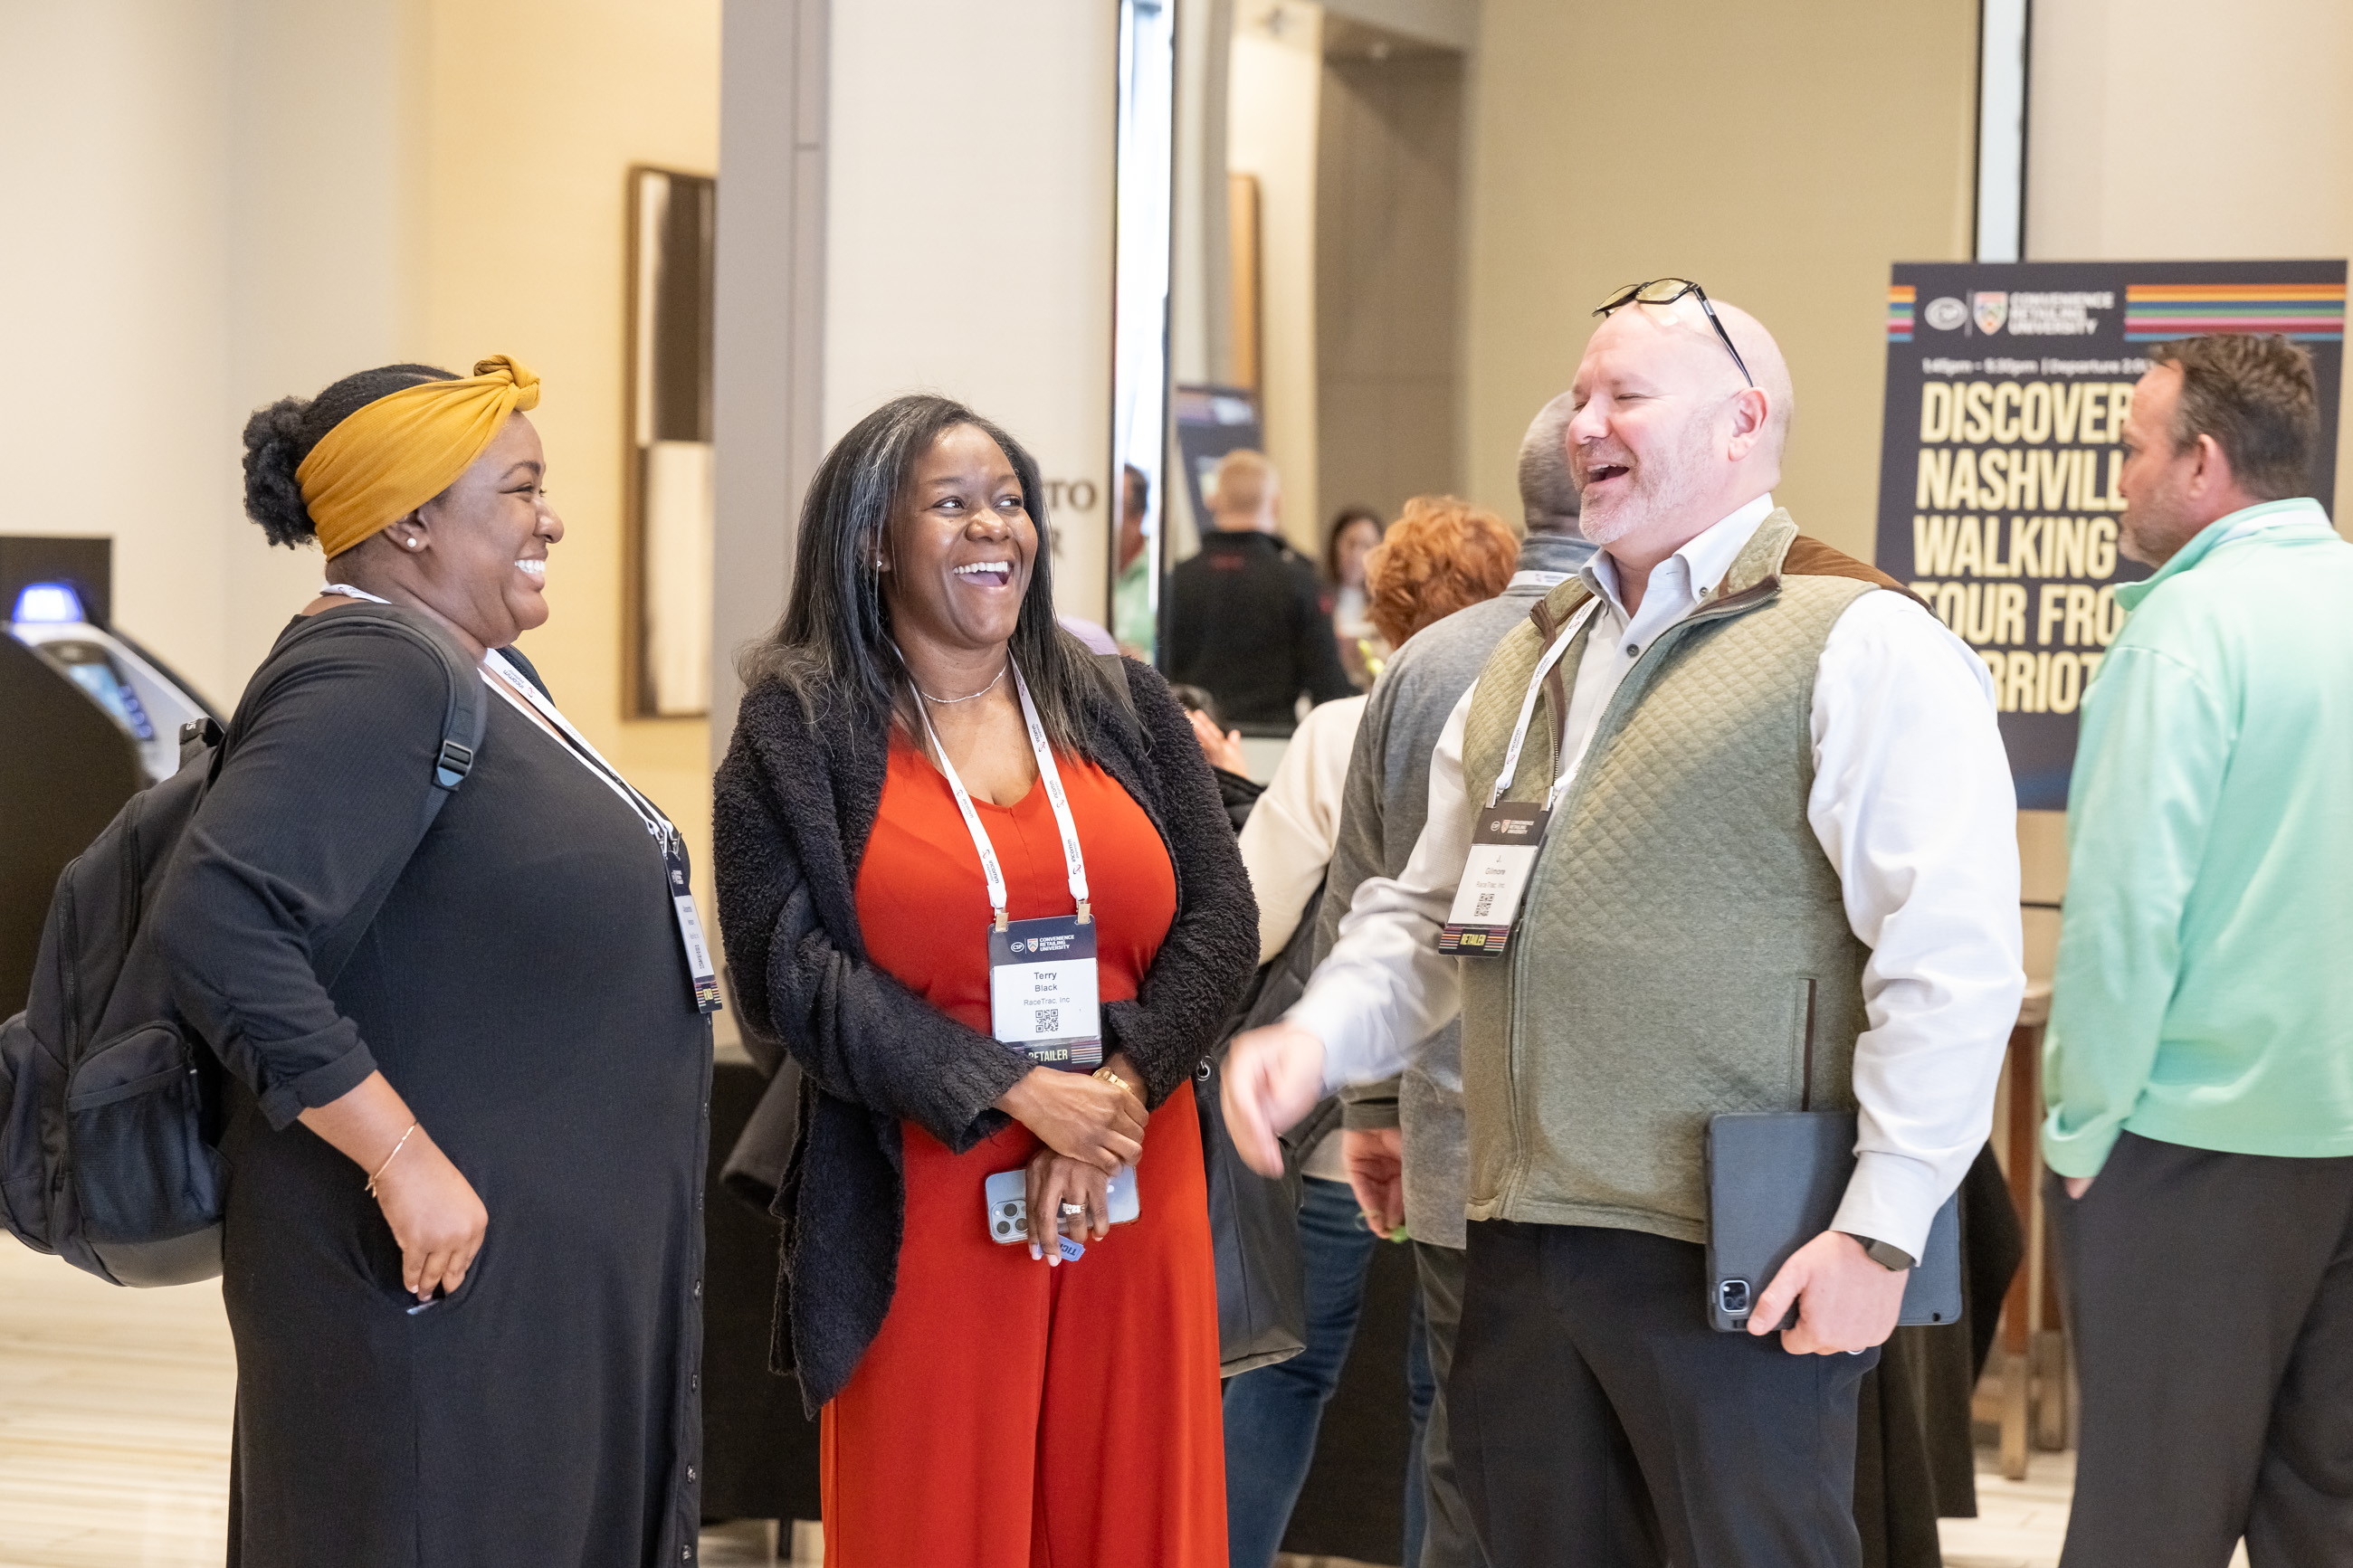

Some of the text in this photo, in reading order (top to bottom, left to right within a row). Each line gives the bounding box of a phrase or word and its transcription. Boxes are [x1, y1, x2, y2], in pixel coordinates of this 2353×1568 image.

[1920, 381, 2137, 444] DISCOVER
[1912, 515, 2120, 579] WALKING
[1908, 581, 2028, 645] TOUR
[1039, 934, 1075, 943] CONVENIENCE
[1039, 944, 1071, 952] UNIVERSITY
[1034, 972, 1057, 981] Terry
[1034, 984, 1058, 993] Black
